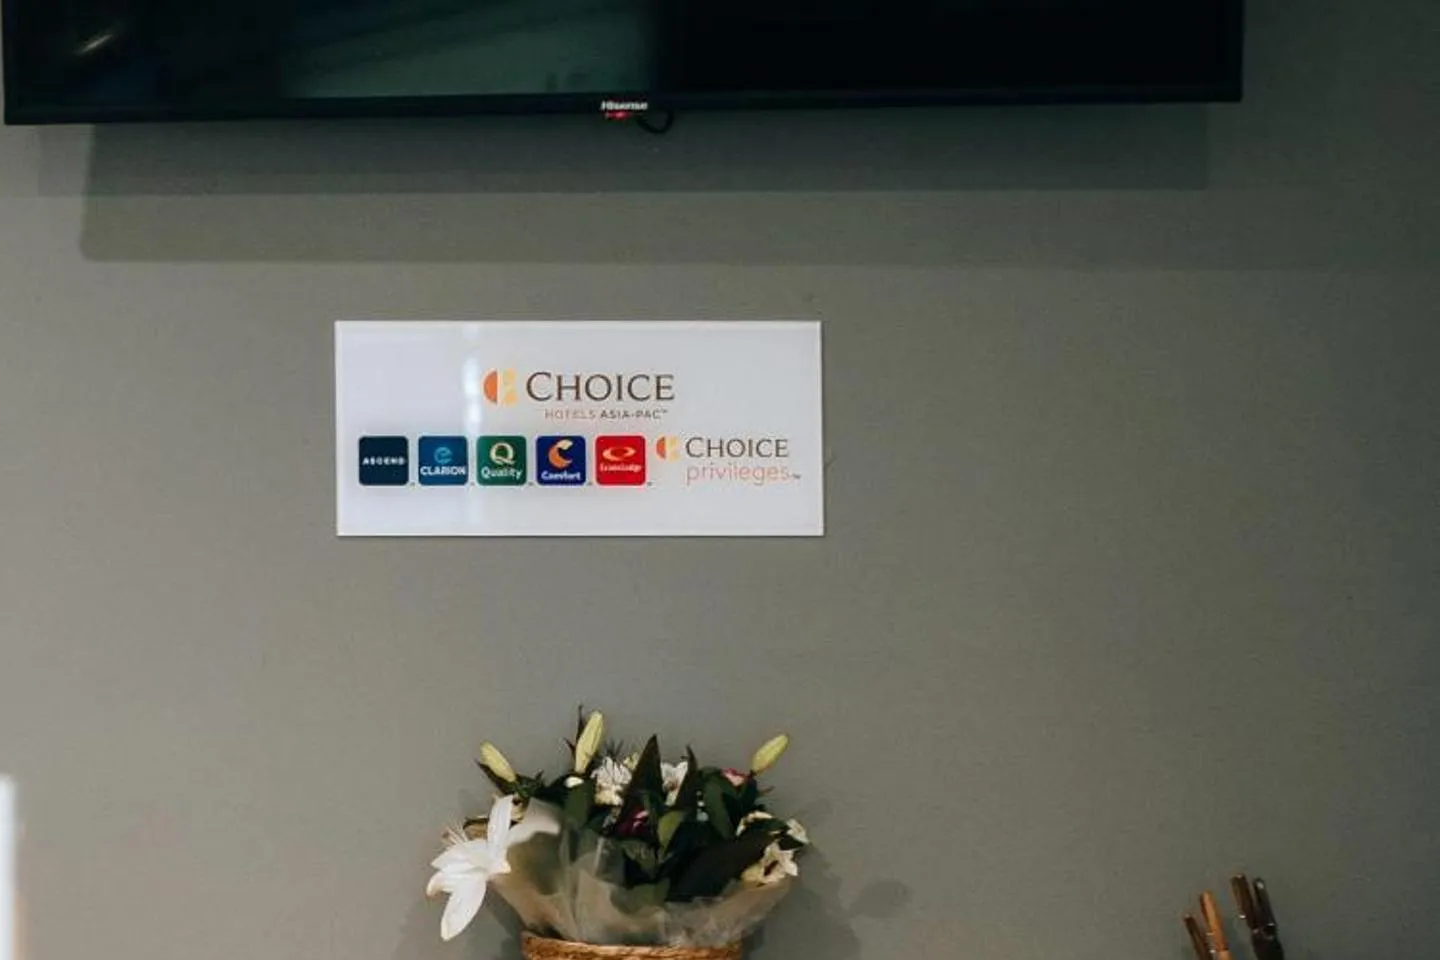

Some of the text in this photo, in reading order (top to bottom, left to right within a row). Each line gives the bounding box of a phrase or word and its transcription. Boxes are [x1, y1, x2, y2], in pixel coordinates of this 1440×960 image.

[526, 371, 675, 401] CHOICE
[545, 409, 596, 420] HOTELS
[685, 437, 789, 458] CHOICE
[362, 456, 406, 466] ASCEND
[420, 465, 467, 476] CLARION
[481, 466, 523, 480] Quality
[541, 470, 581, 481] Comfort
[686, 461, 791, 487] privileges
